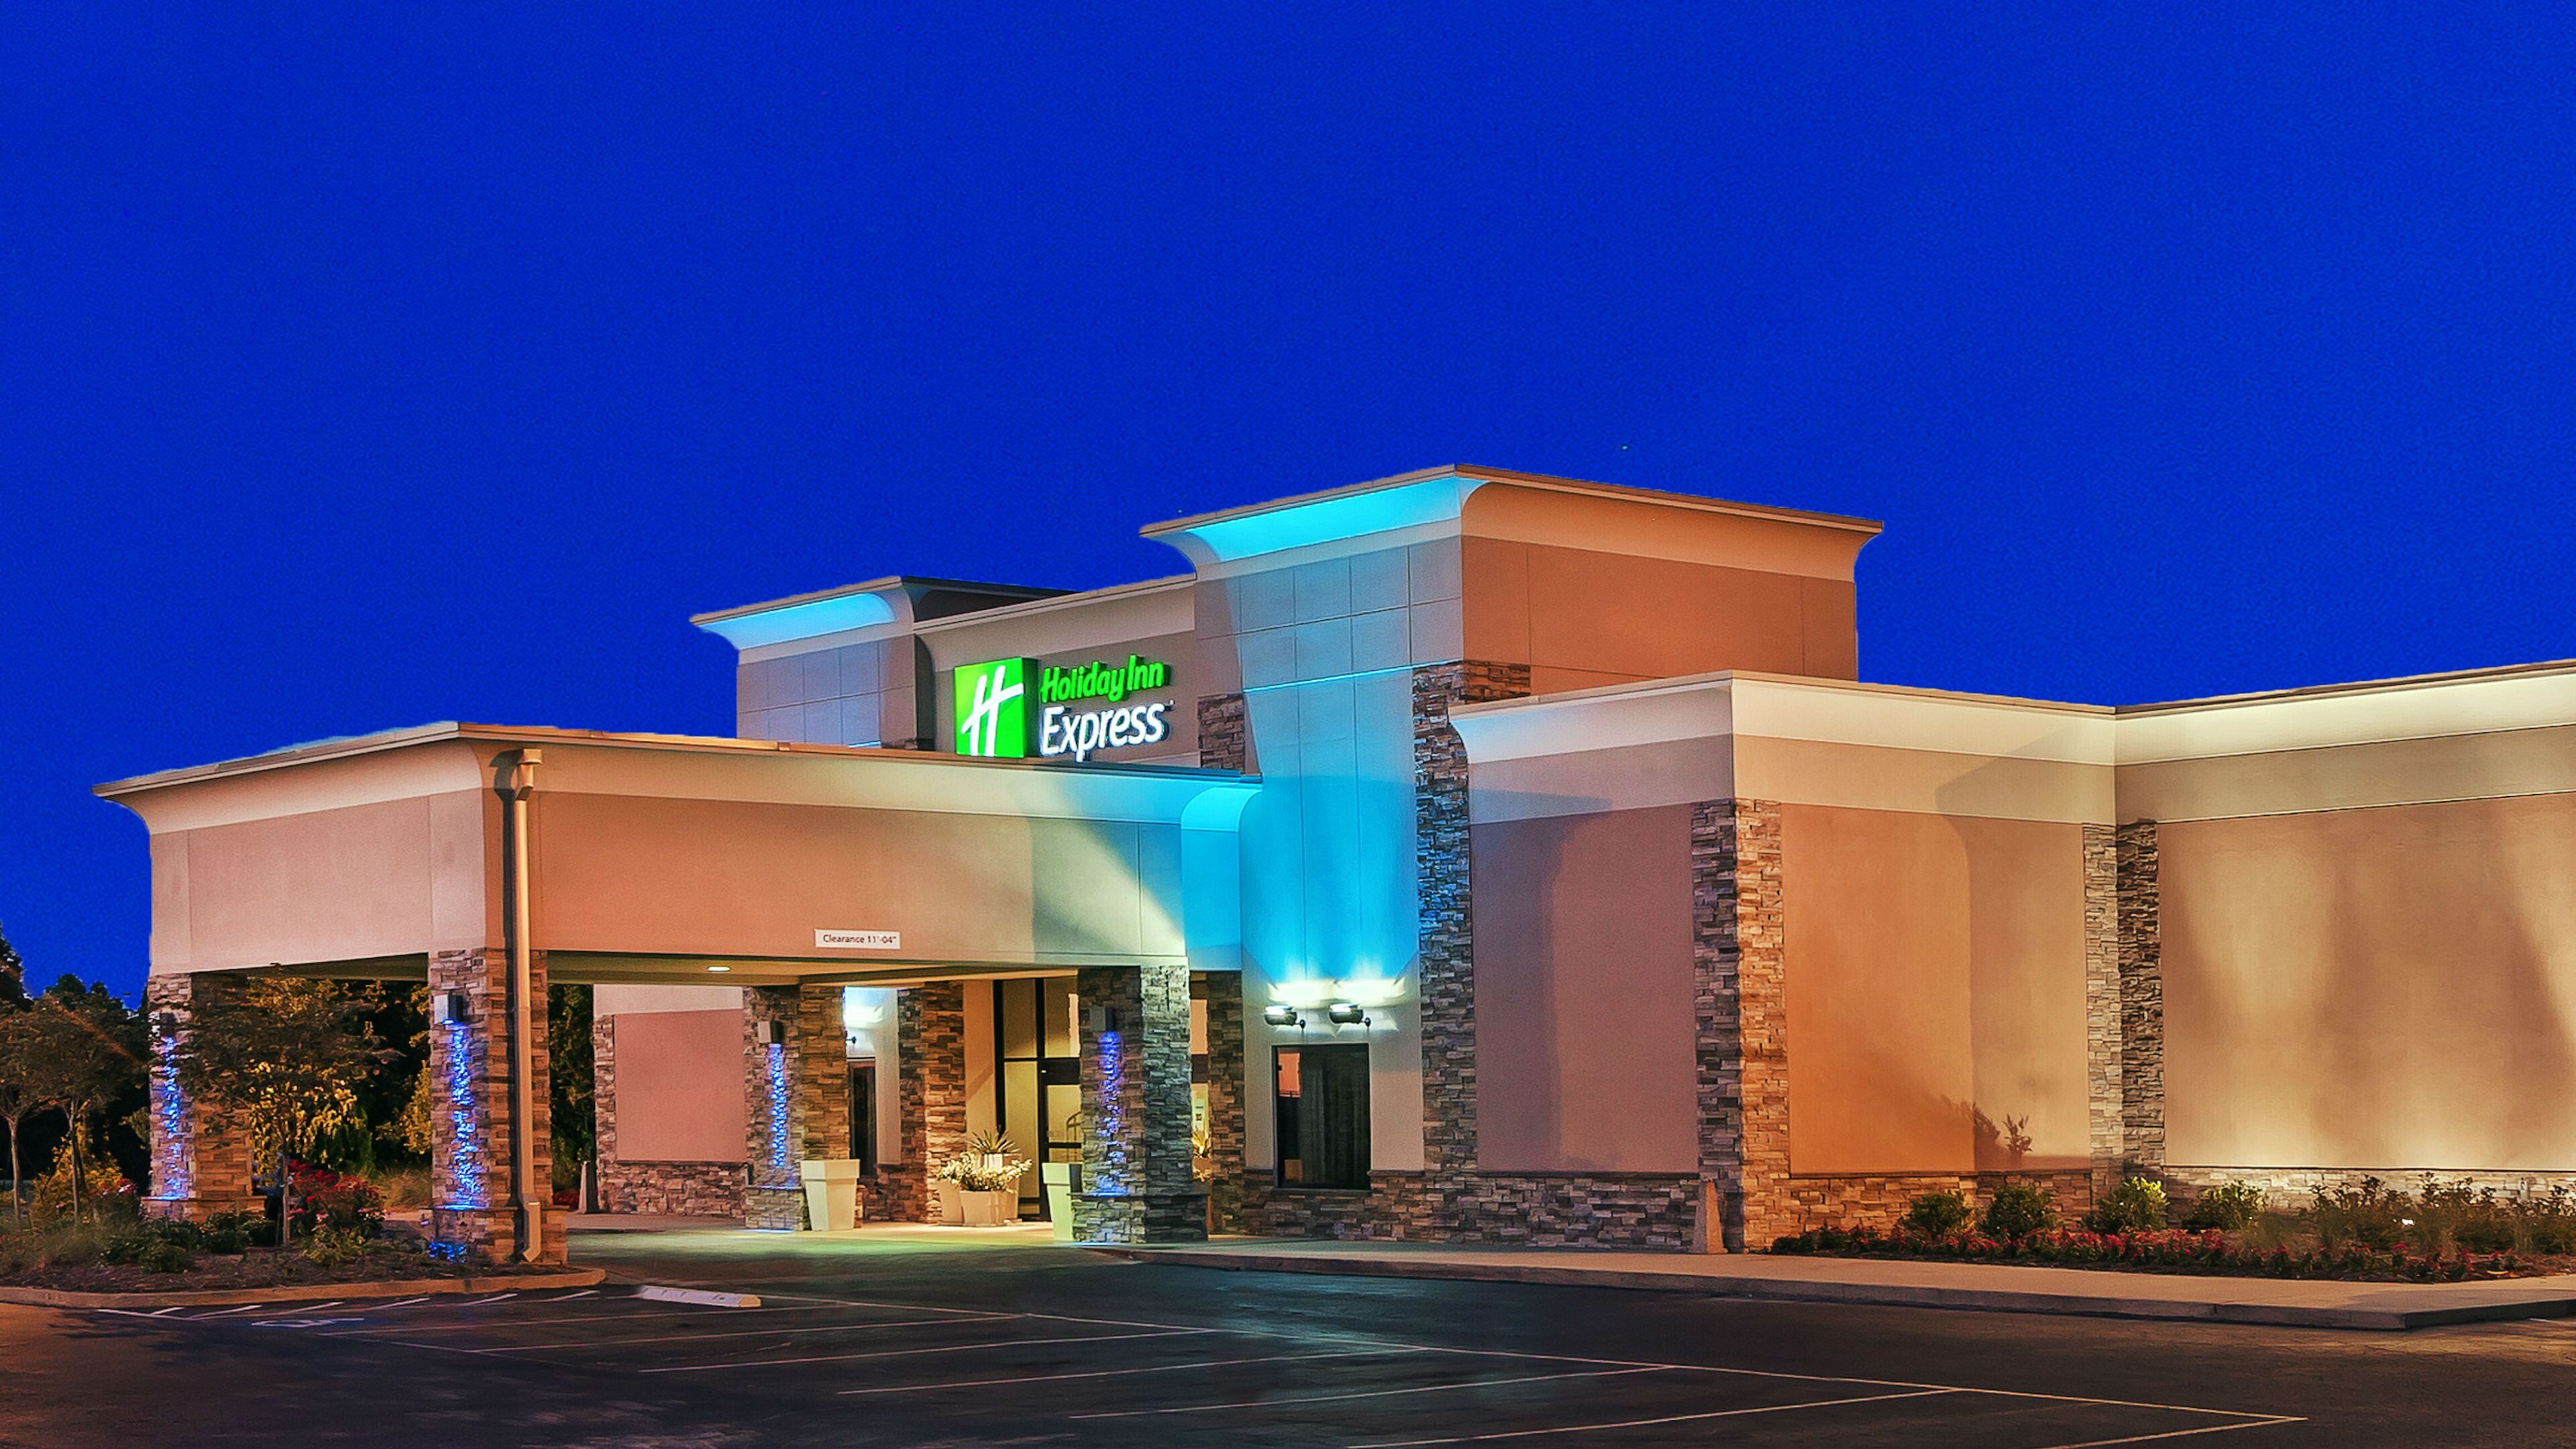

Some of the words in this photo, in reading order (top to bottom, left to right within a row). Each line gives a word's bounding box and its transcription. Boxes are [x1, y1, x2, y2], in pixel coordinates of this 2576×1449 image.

[1040, 661, 1126, 702] Holiday
[1127, 654, 1165, 691] Inn
[1041, 702, 1166, 763] Express
[822, 934, 865, 943] Clearance
